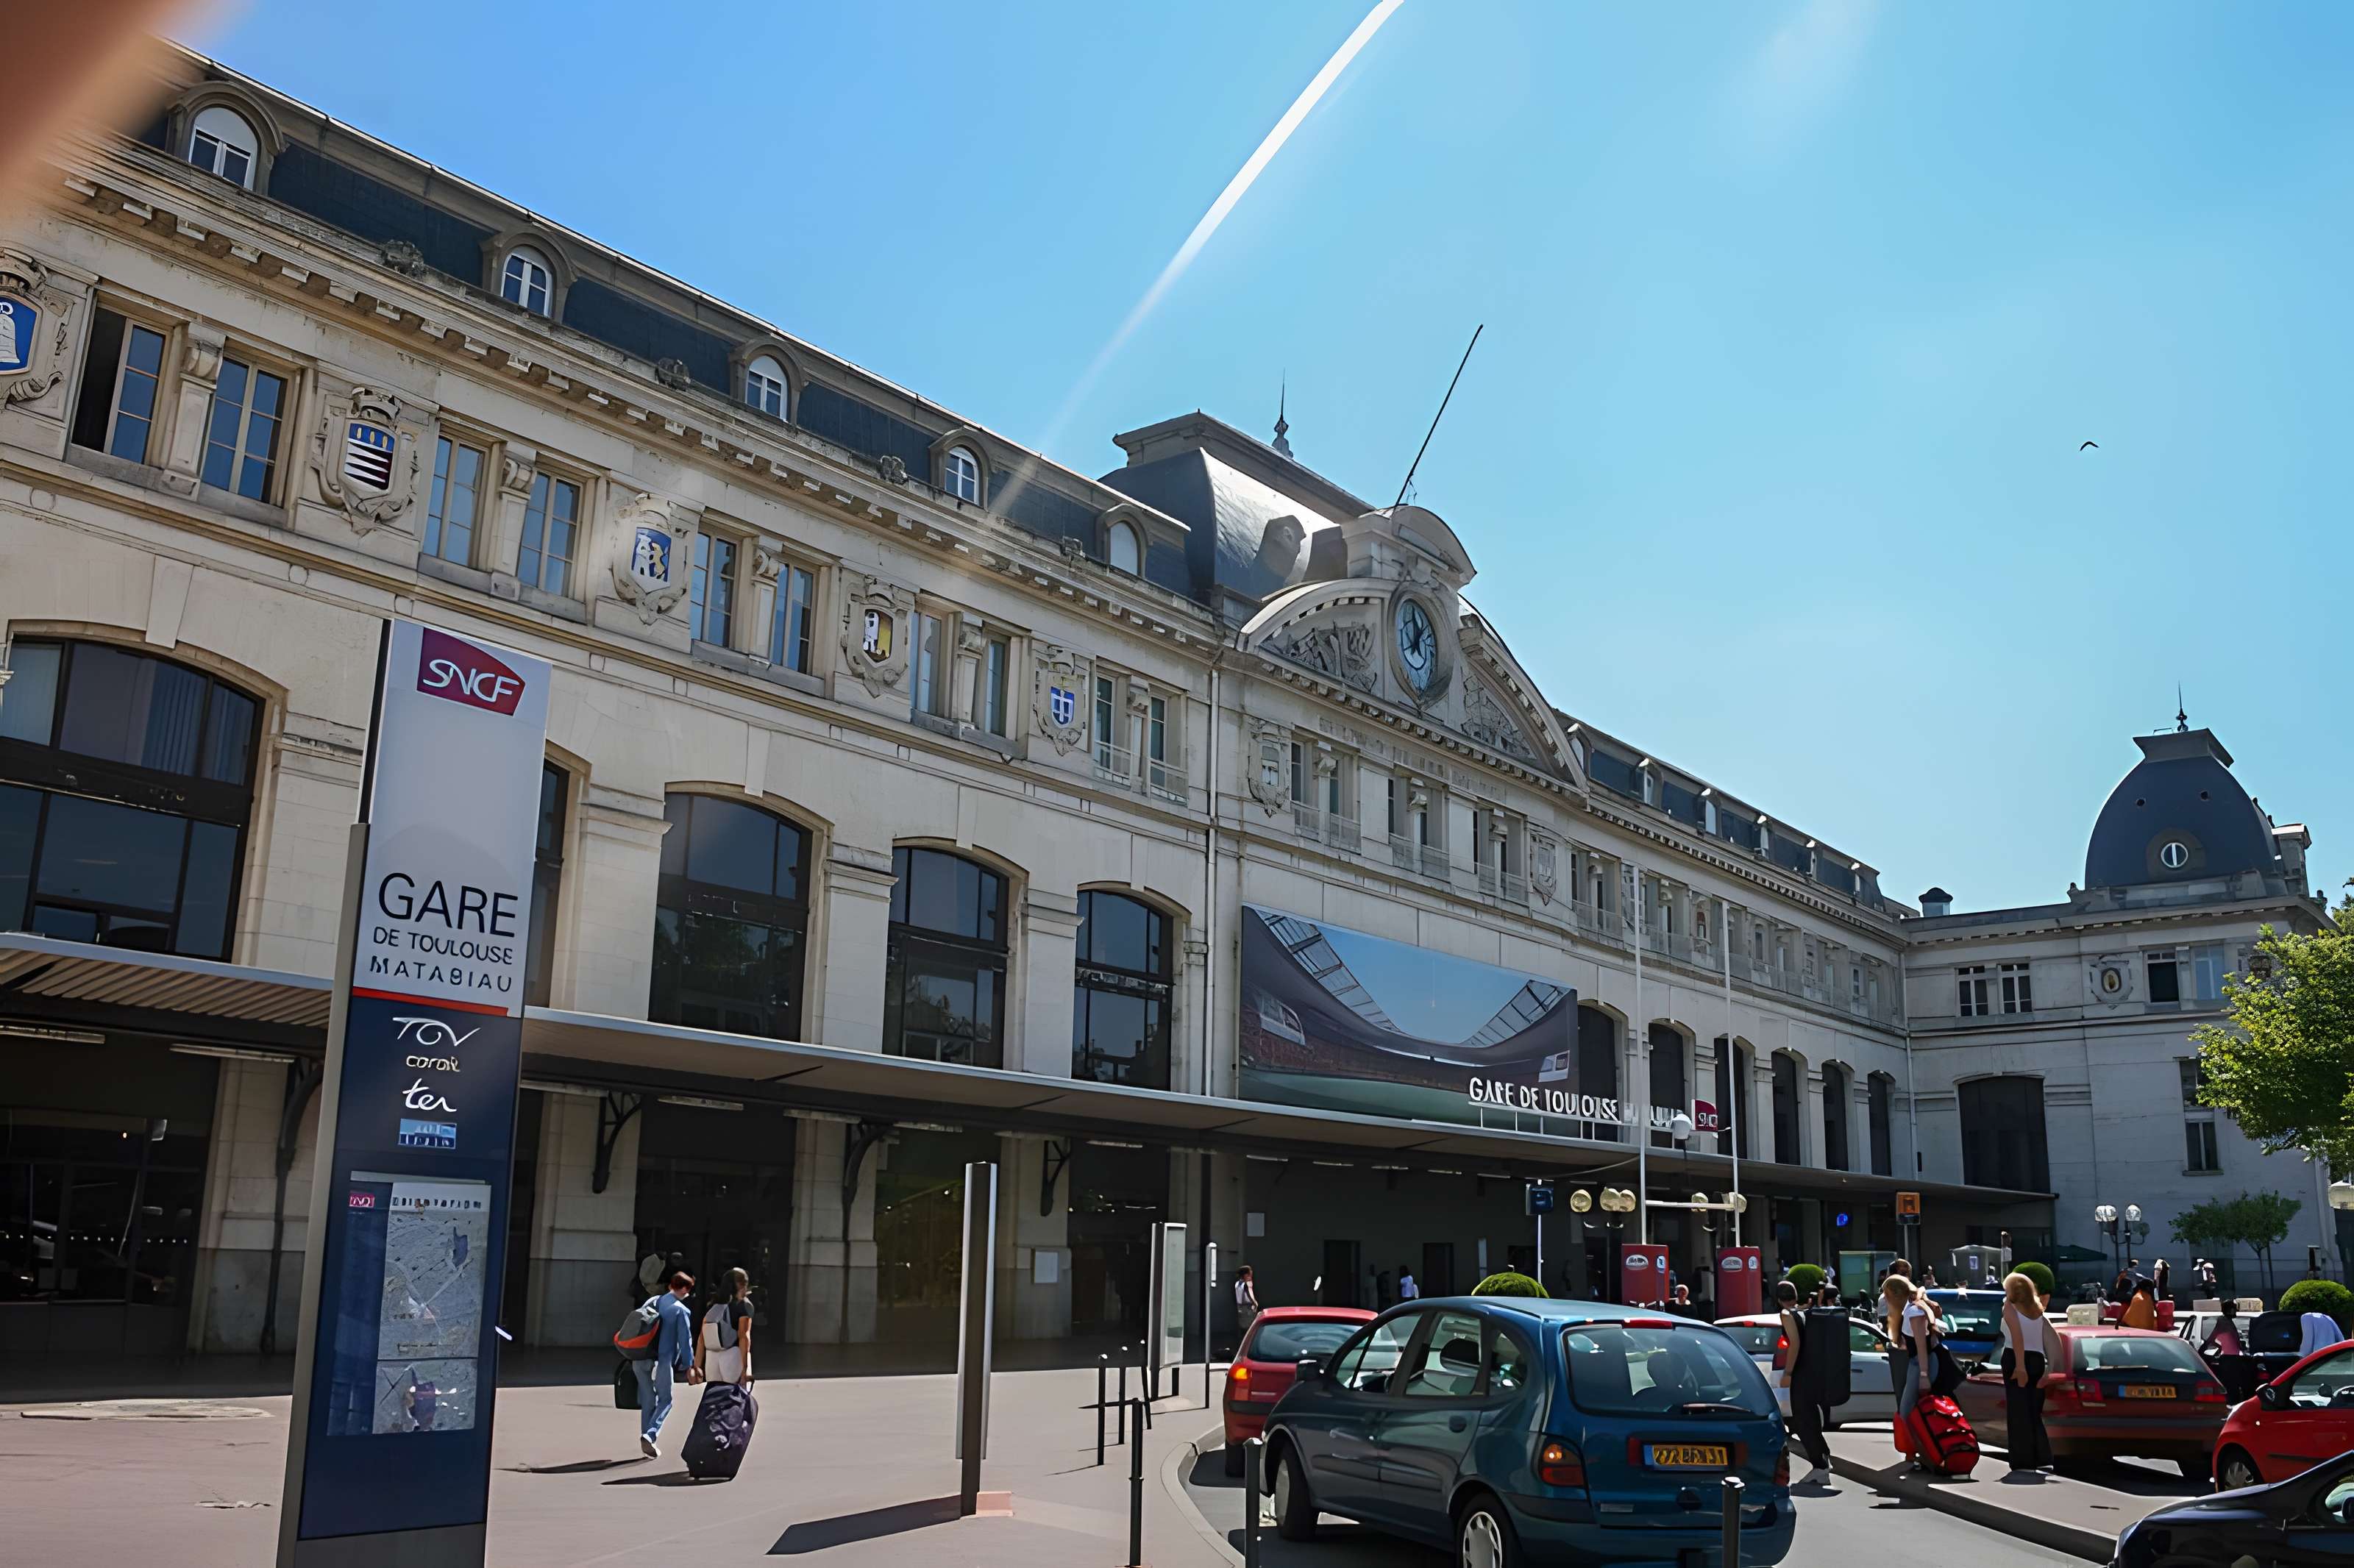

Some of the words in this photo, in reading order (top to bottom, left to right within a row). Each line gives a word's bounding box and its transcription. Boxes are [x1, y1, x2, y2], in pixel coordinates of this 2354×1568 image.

[423, 659, 519, 702] SNCF
[379, 872, 518, 938] GARE
[373, 927, 400, 947] DE
[408, 932, 513, 965] TOULOUSE
[402, 1078, 458, 1112] ter
[1519, 1086, 1540, 1109] DE
